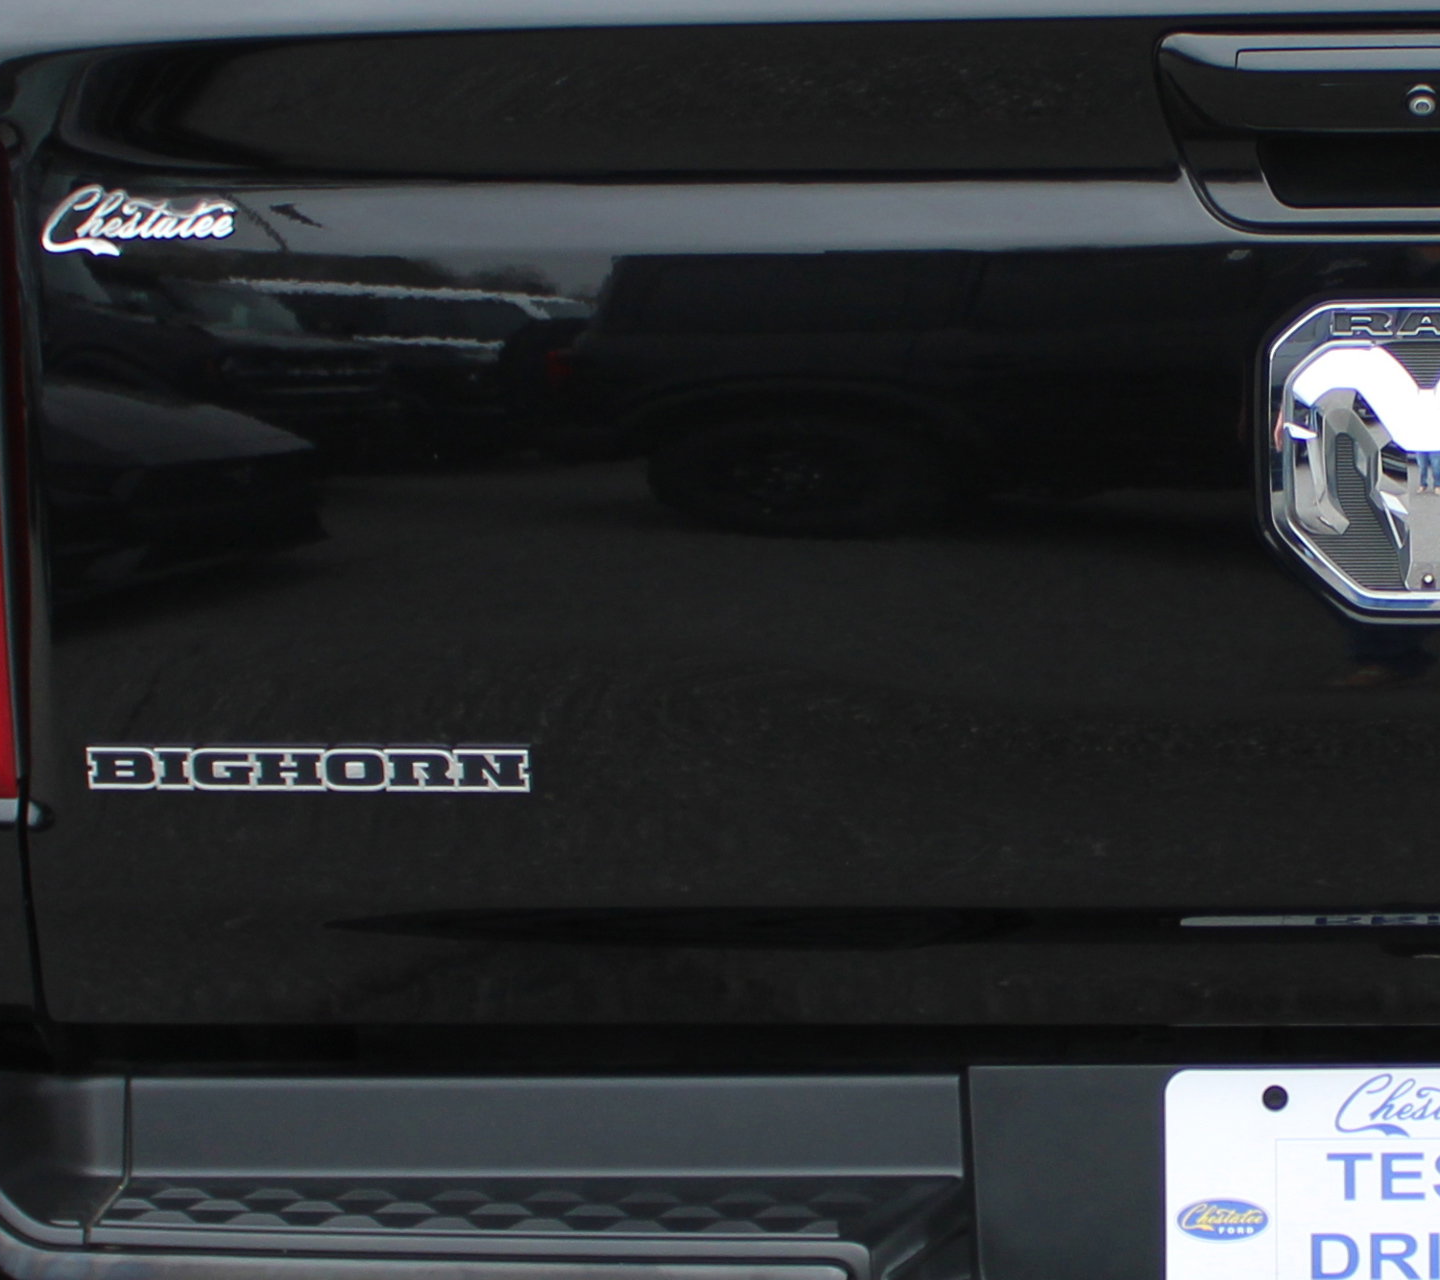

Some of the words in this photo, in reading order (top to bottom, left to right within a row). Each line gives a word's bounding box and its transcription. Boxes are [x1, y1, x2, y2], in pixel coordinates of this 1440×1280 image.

[42, 185, 239, 257] Chestatee
[86, 745, 531, 792] BIGHORN
[1218, 1226, 1254, 1235] FORD
